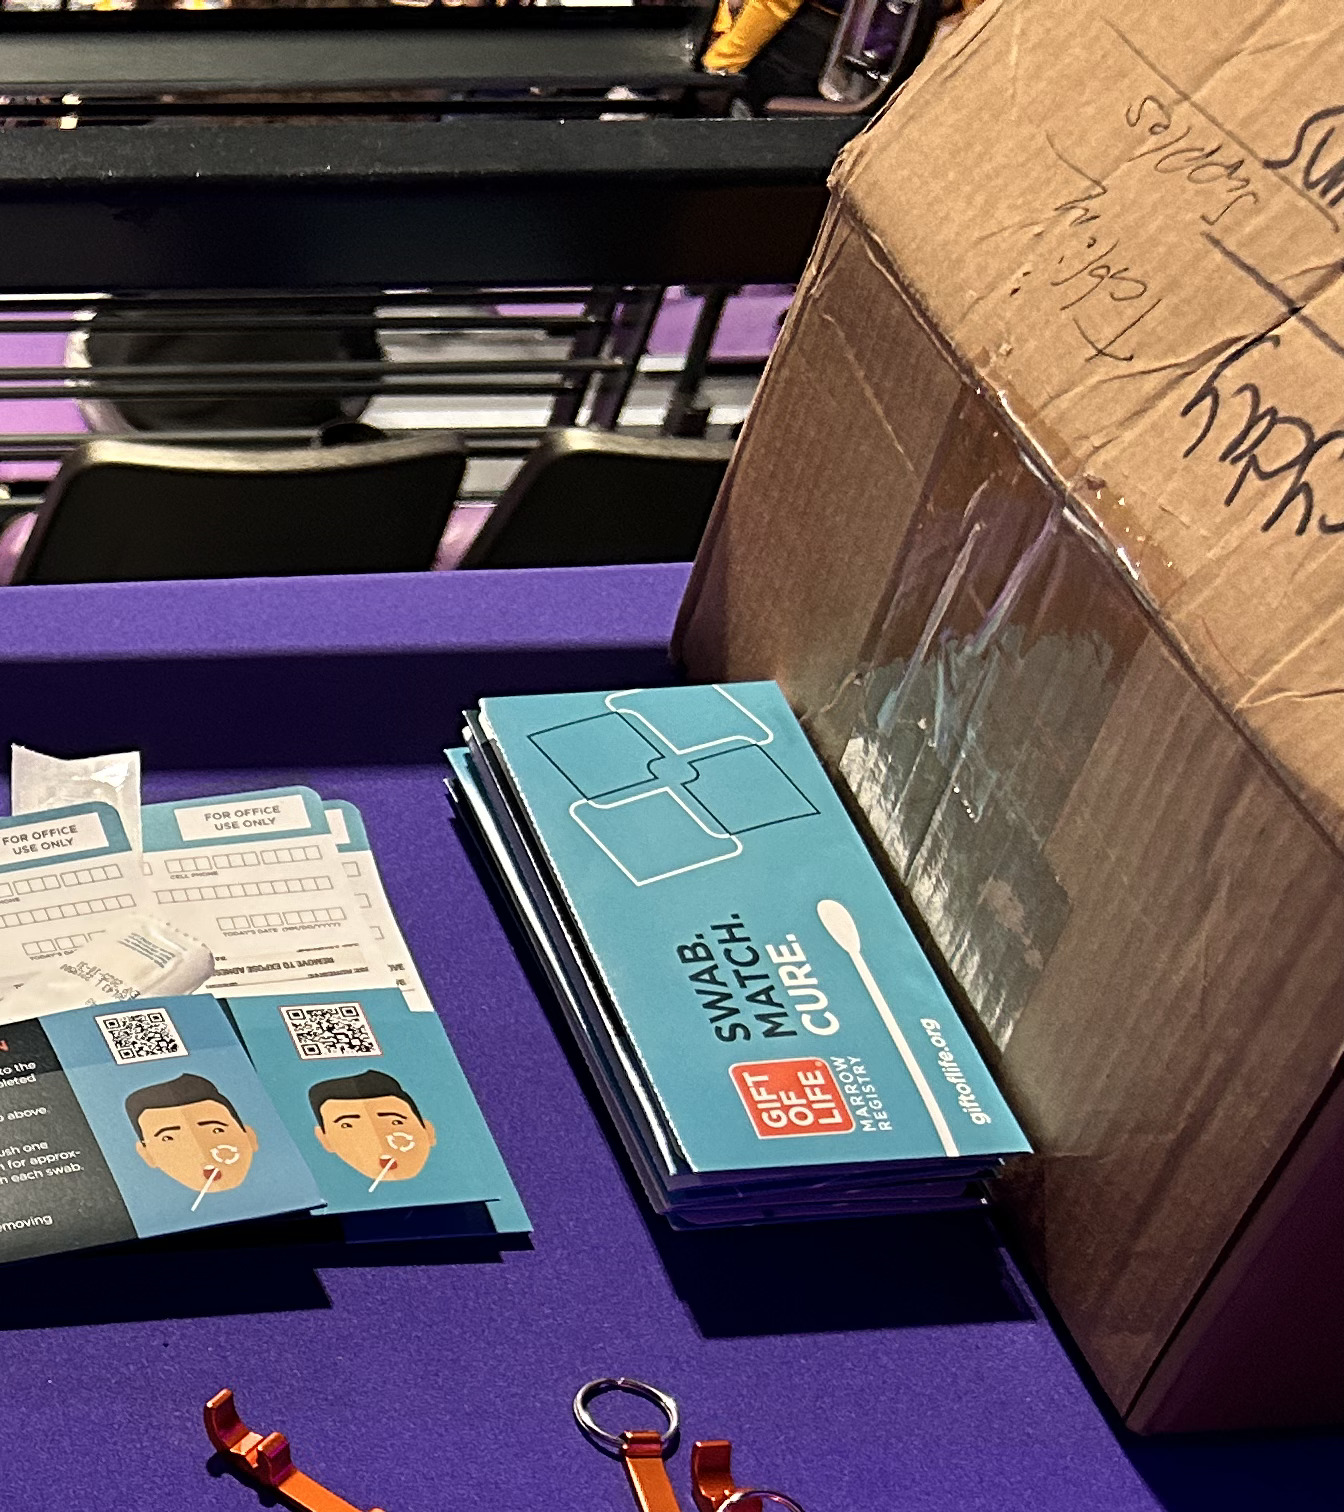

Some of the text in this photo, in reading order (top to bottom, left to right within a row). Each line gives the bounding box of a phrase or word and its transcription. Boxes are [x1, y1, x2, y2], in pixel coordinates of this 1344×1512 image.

[2, 824, 78, 846] FOR OFFICE
[205, 805, 281, 821] FOR OFFICE
[214, 818, 276, 831] USE ONLY
[12, 837, 73, 855] USE ONLY
[676, 933, 751, 1044] SWAB.
[711, 914, 798, 1040] MATCH.
[766, 934, 840, 1036] CURE.
[742, 1072, 789, 1127] GIFT
[797, 1071, 843, 1124] LIFE
[830, 1056, 877, 1132] MARROW
[847, 1056, 893, 1131] REGISTRY
[918, 1018, 992, 1126] giftoflife.org
[779, 1091, 814, 1126] OF
